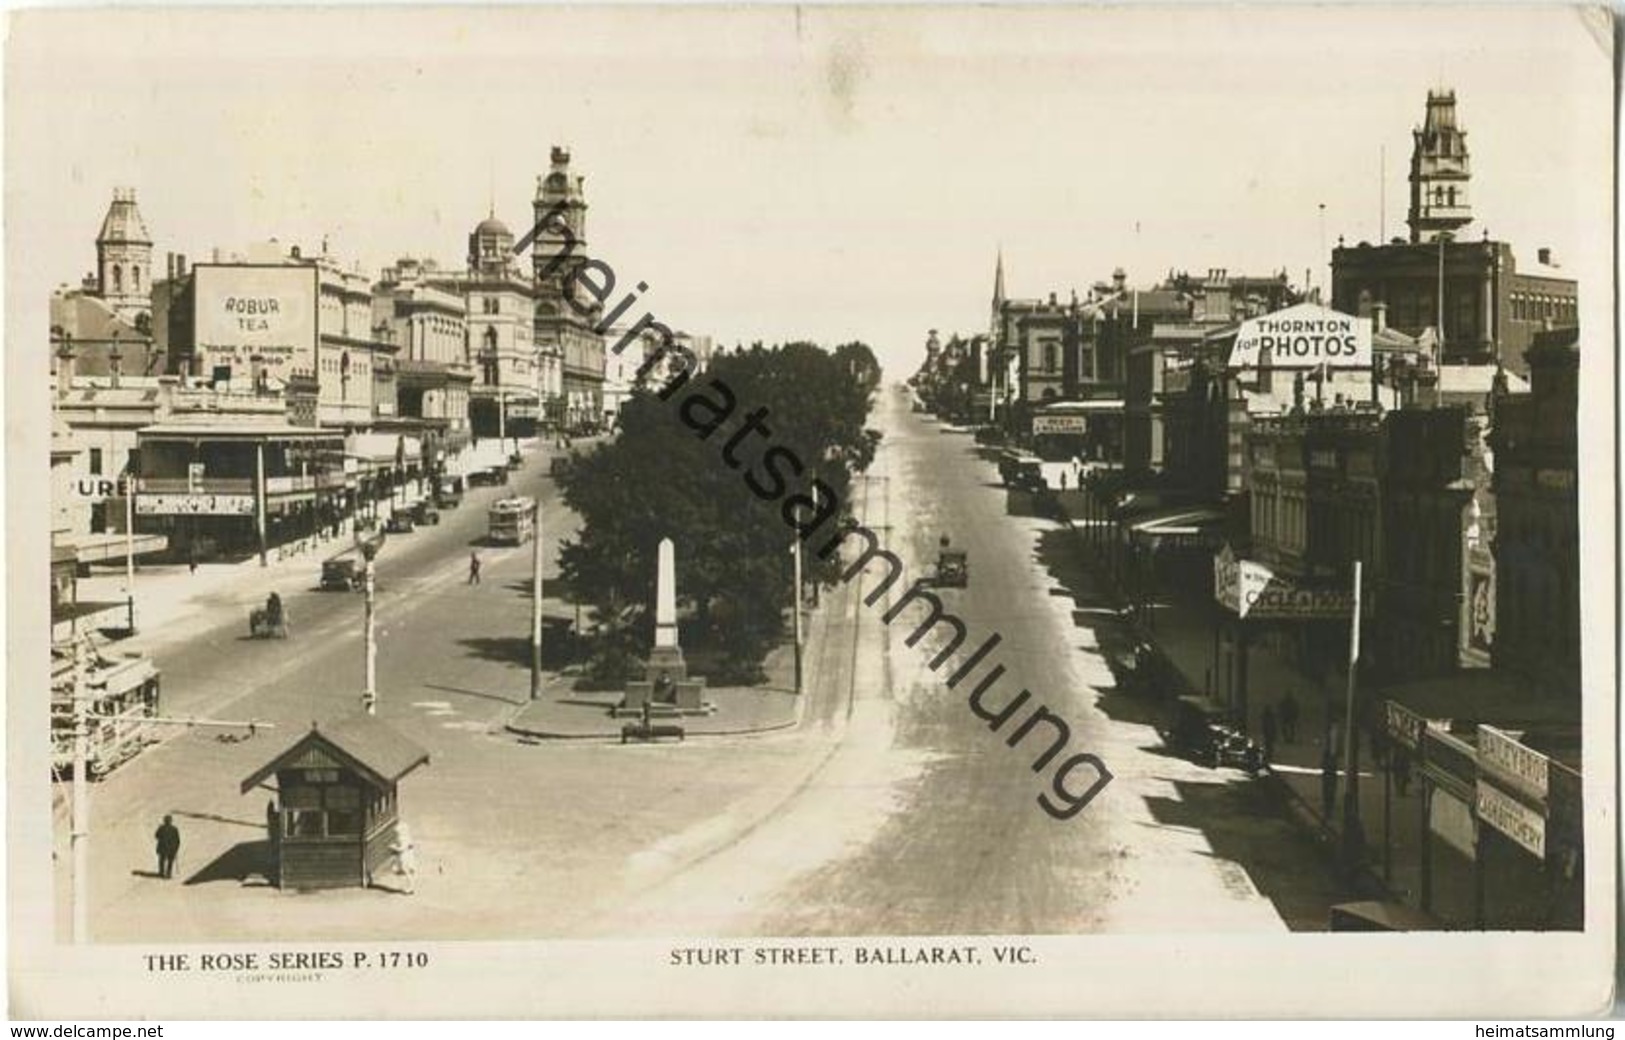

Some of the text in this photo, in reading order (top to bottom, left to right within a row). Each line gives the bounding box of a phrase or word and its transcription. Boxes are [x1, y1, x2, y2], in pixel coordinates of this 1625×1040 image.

[226, 297, 280, 315] ROBUR
[239, 319, 269, 331] TEA
[1257, 321, 1350, 333] THORNTON
